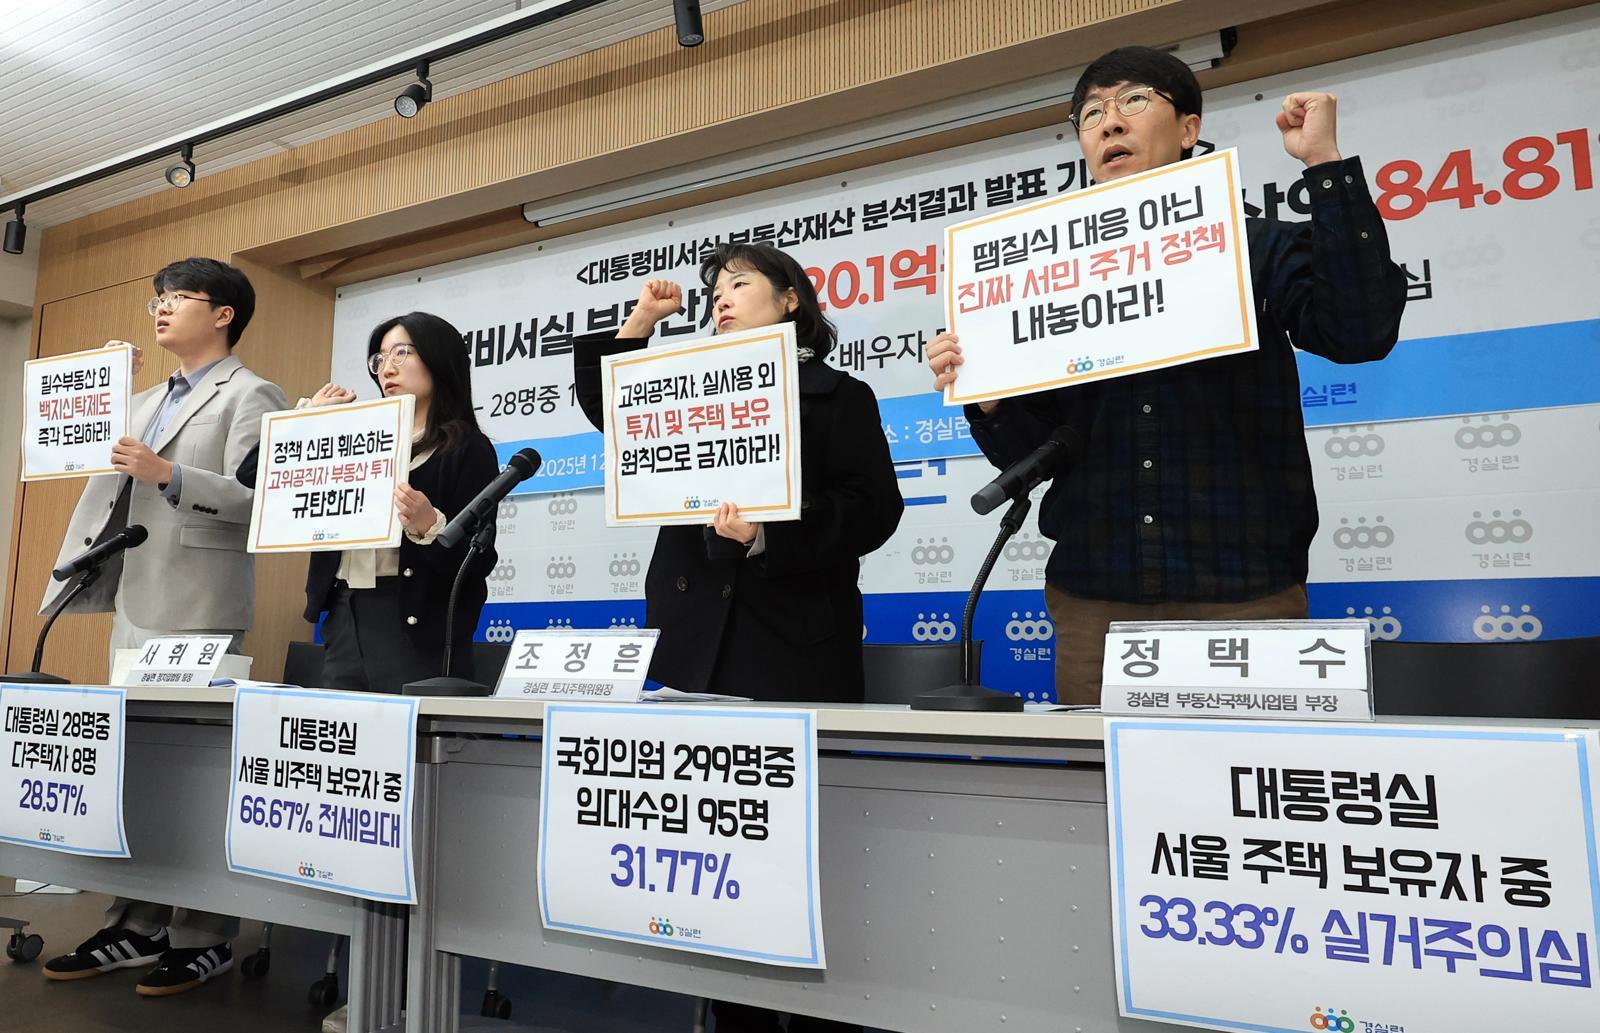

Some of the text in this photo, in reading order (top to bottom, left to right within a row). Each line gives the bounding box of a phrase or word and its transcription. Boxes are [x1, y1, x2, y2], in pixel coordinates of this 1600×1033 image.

[862, 182, 977, 232] 분석결과
[985, 167, 1048, 208] 발표
[973, 224, 1059, 273] 땜질식
[1069, 207, 1130, 250] 대응
[1139, 185, 1204, 231] 아닌
[803, 245, 944, 312] 20.1억
[958, 222, 1226, 314] 진짜 서민 주거 정책
[1012, 279, 1165, 345] 내놓아라!
[41, 366, 111, 395] 필수부동산 외
[703, 365, 753, 396] 실사용
[758, 361, 776, 388] 외
[39, 392, 111, 421] 백지신탁제도
[490, 384, 560, 418] 28명중
[664, 409, 683, 437] 및
[688, 403, 725, 434] 주택
[731, 398, 771, 429] 보유
[38, 421, 111, 447] 즉각 도입하라!
[274, 430, 393, 464] 정책 신뢰 훼손하는
[537, 454, 586, 477] 2025년
[621, 433, 780, 476] 원칙으로 금지하라!
[1331, 464, 1383, 481] 경실련
[1461, 455, 1520, 473] 경실련
[268, 458, 394, 490] 고위공직자 부동산 투기
[292, 487, 365, 519] 규탄한다!
[1339, 556, 1392, 573] 경실련
[1472, 551, 1531, 569] 경실련
[1126, 691, 1338, 712] 경실련 부동산국책사업팀 부장
[4, 706, 110, 741] 대통령실 28명중
[280, 716, 357, 755] 대통령실
[11, 741, 97, 775] 다주택자 8명
[557, 736, 796, 788] 국회의원 299명중
[19, 778, 87, 816] 28.57%
[239, 756, 402, 803] 서울 비주택 보유자 중
[1231, 766, 1439, 829] 대통령실
[240, 794, 401, 848] 66.67% 전세임대
[577, 787, 769, 841] 임대수입 95명
[610, 843, 740, 900] 31.77%
[1151, 832, 1552, 909] 서울 주택 보유자 중
[1139, 894, 1592, 989] 33.33% 실거주의심
